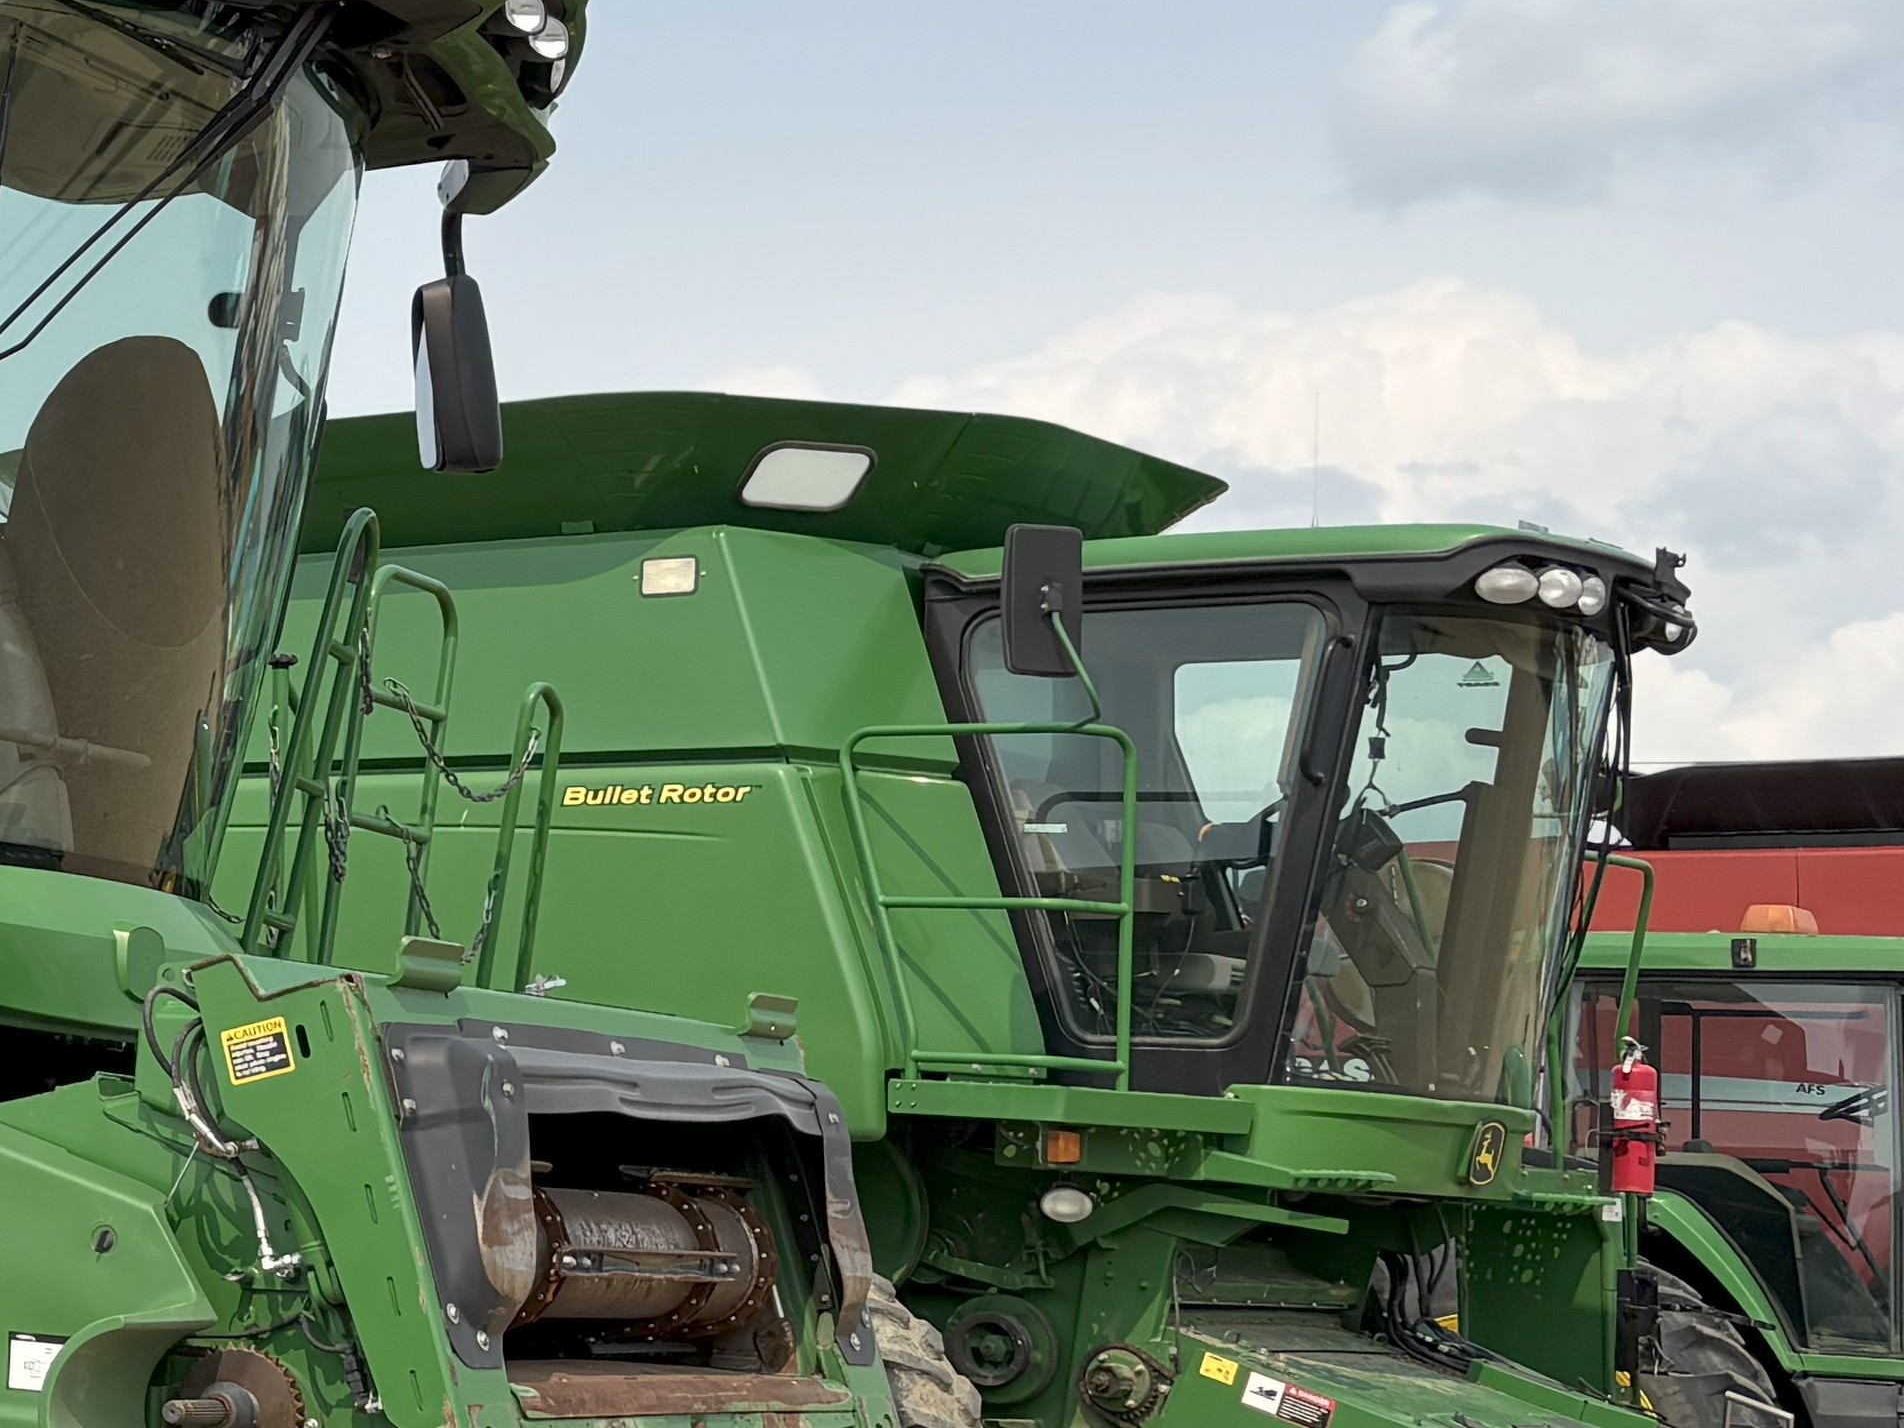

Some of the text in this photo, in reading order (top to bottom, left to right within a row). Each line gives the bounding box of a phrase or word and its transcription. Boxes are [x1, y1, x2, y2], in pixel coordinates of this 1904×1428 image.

[562, 782, 752, 807] Bullet Rotor
[233, 1020, 282, 1040] CAUTION
[1795, 1083, 1826, 1096] AFS
